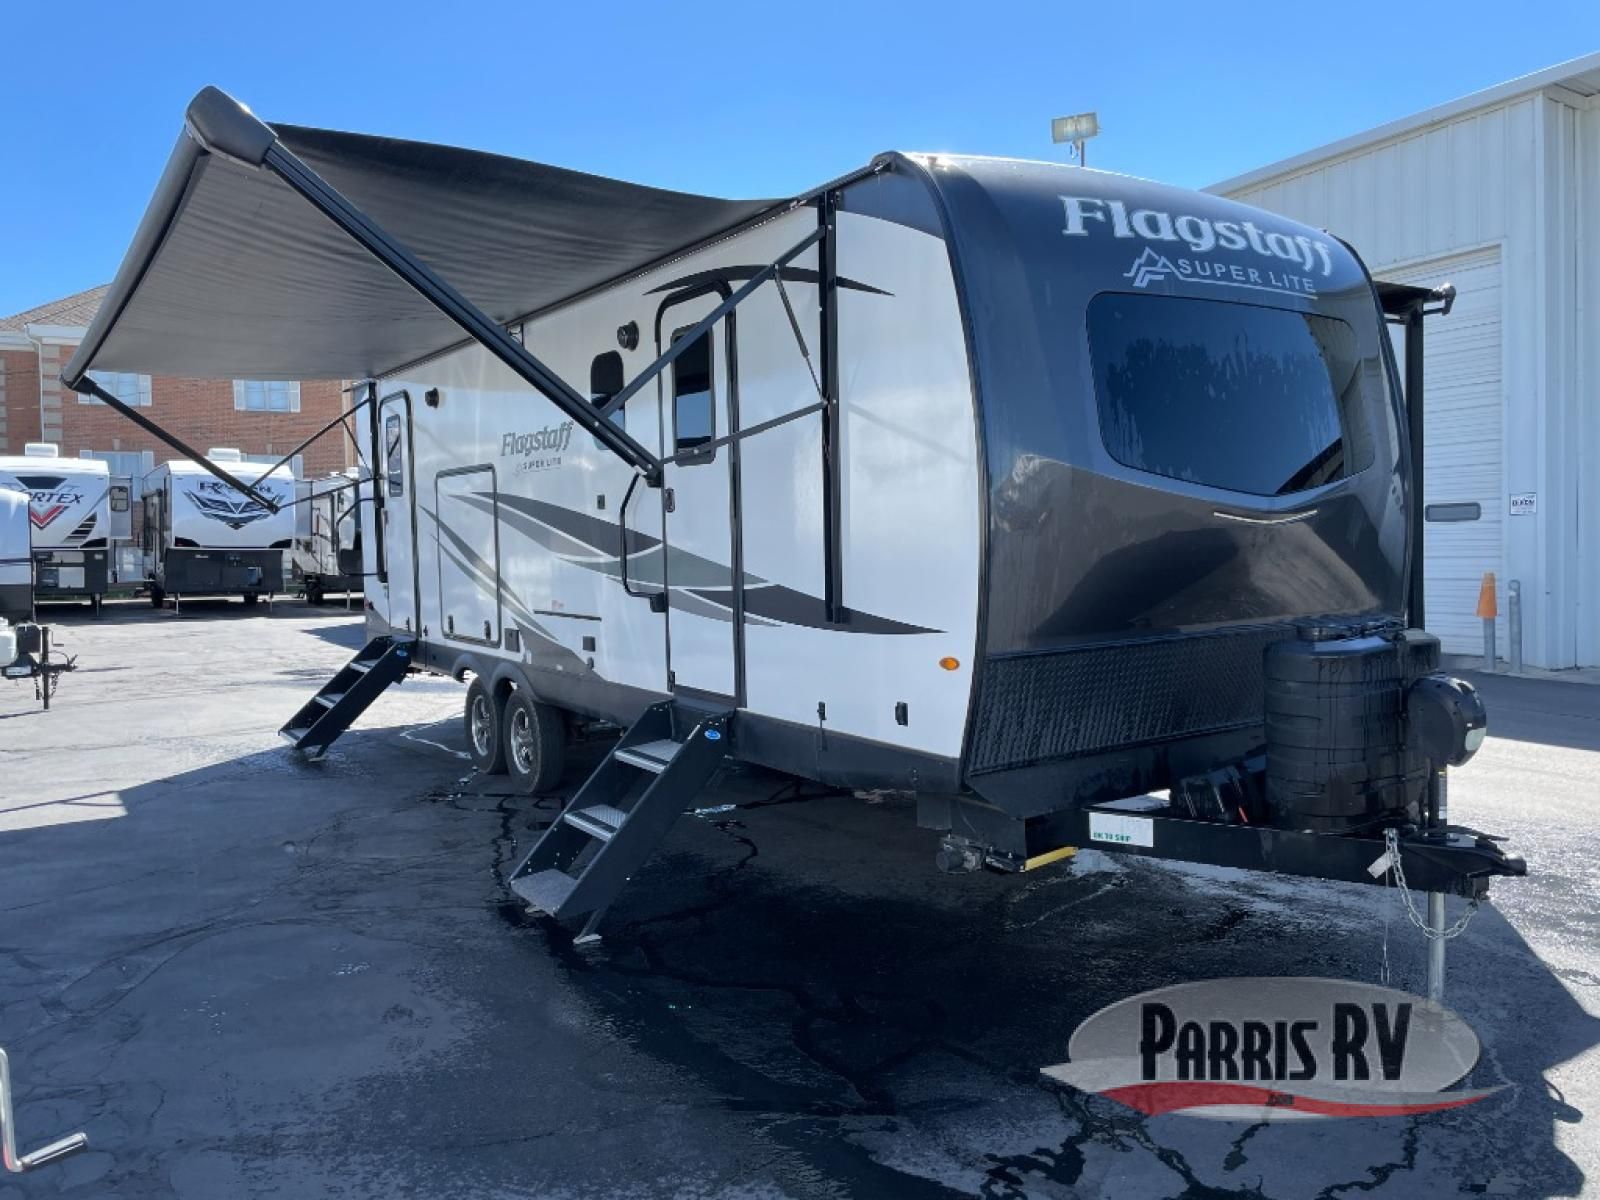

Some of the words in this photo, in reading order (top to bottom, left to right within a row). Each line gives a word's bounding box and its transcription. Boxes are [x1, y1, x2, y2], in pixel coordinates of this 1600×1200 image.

[1057, 195, 1332, 277] Flagstaff
[1177, 258, 1263, 284] SUPER
[1269, 271, 1317, 292] LITE
[501, 420, 574, 456] Flagstaff
